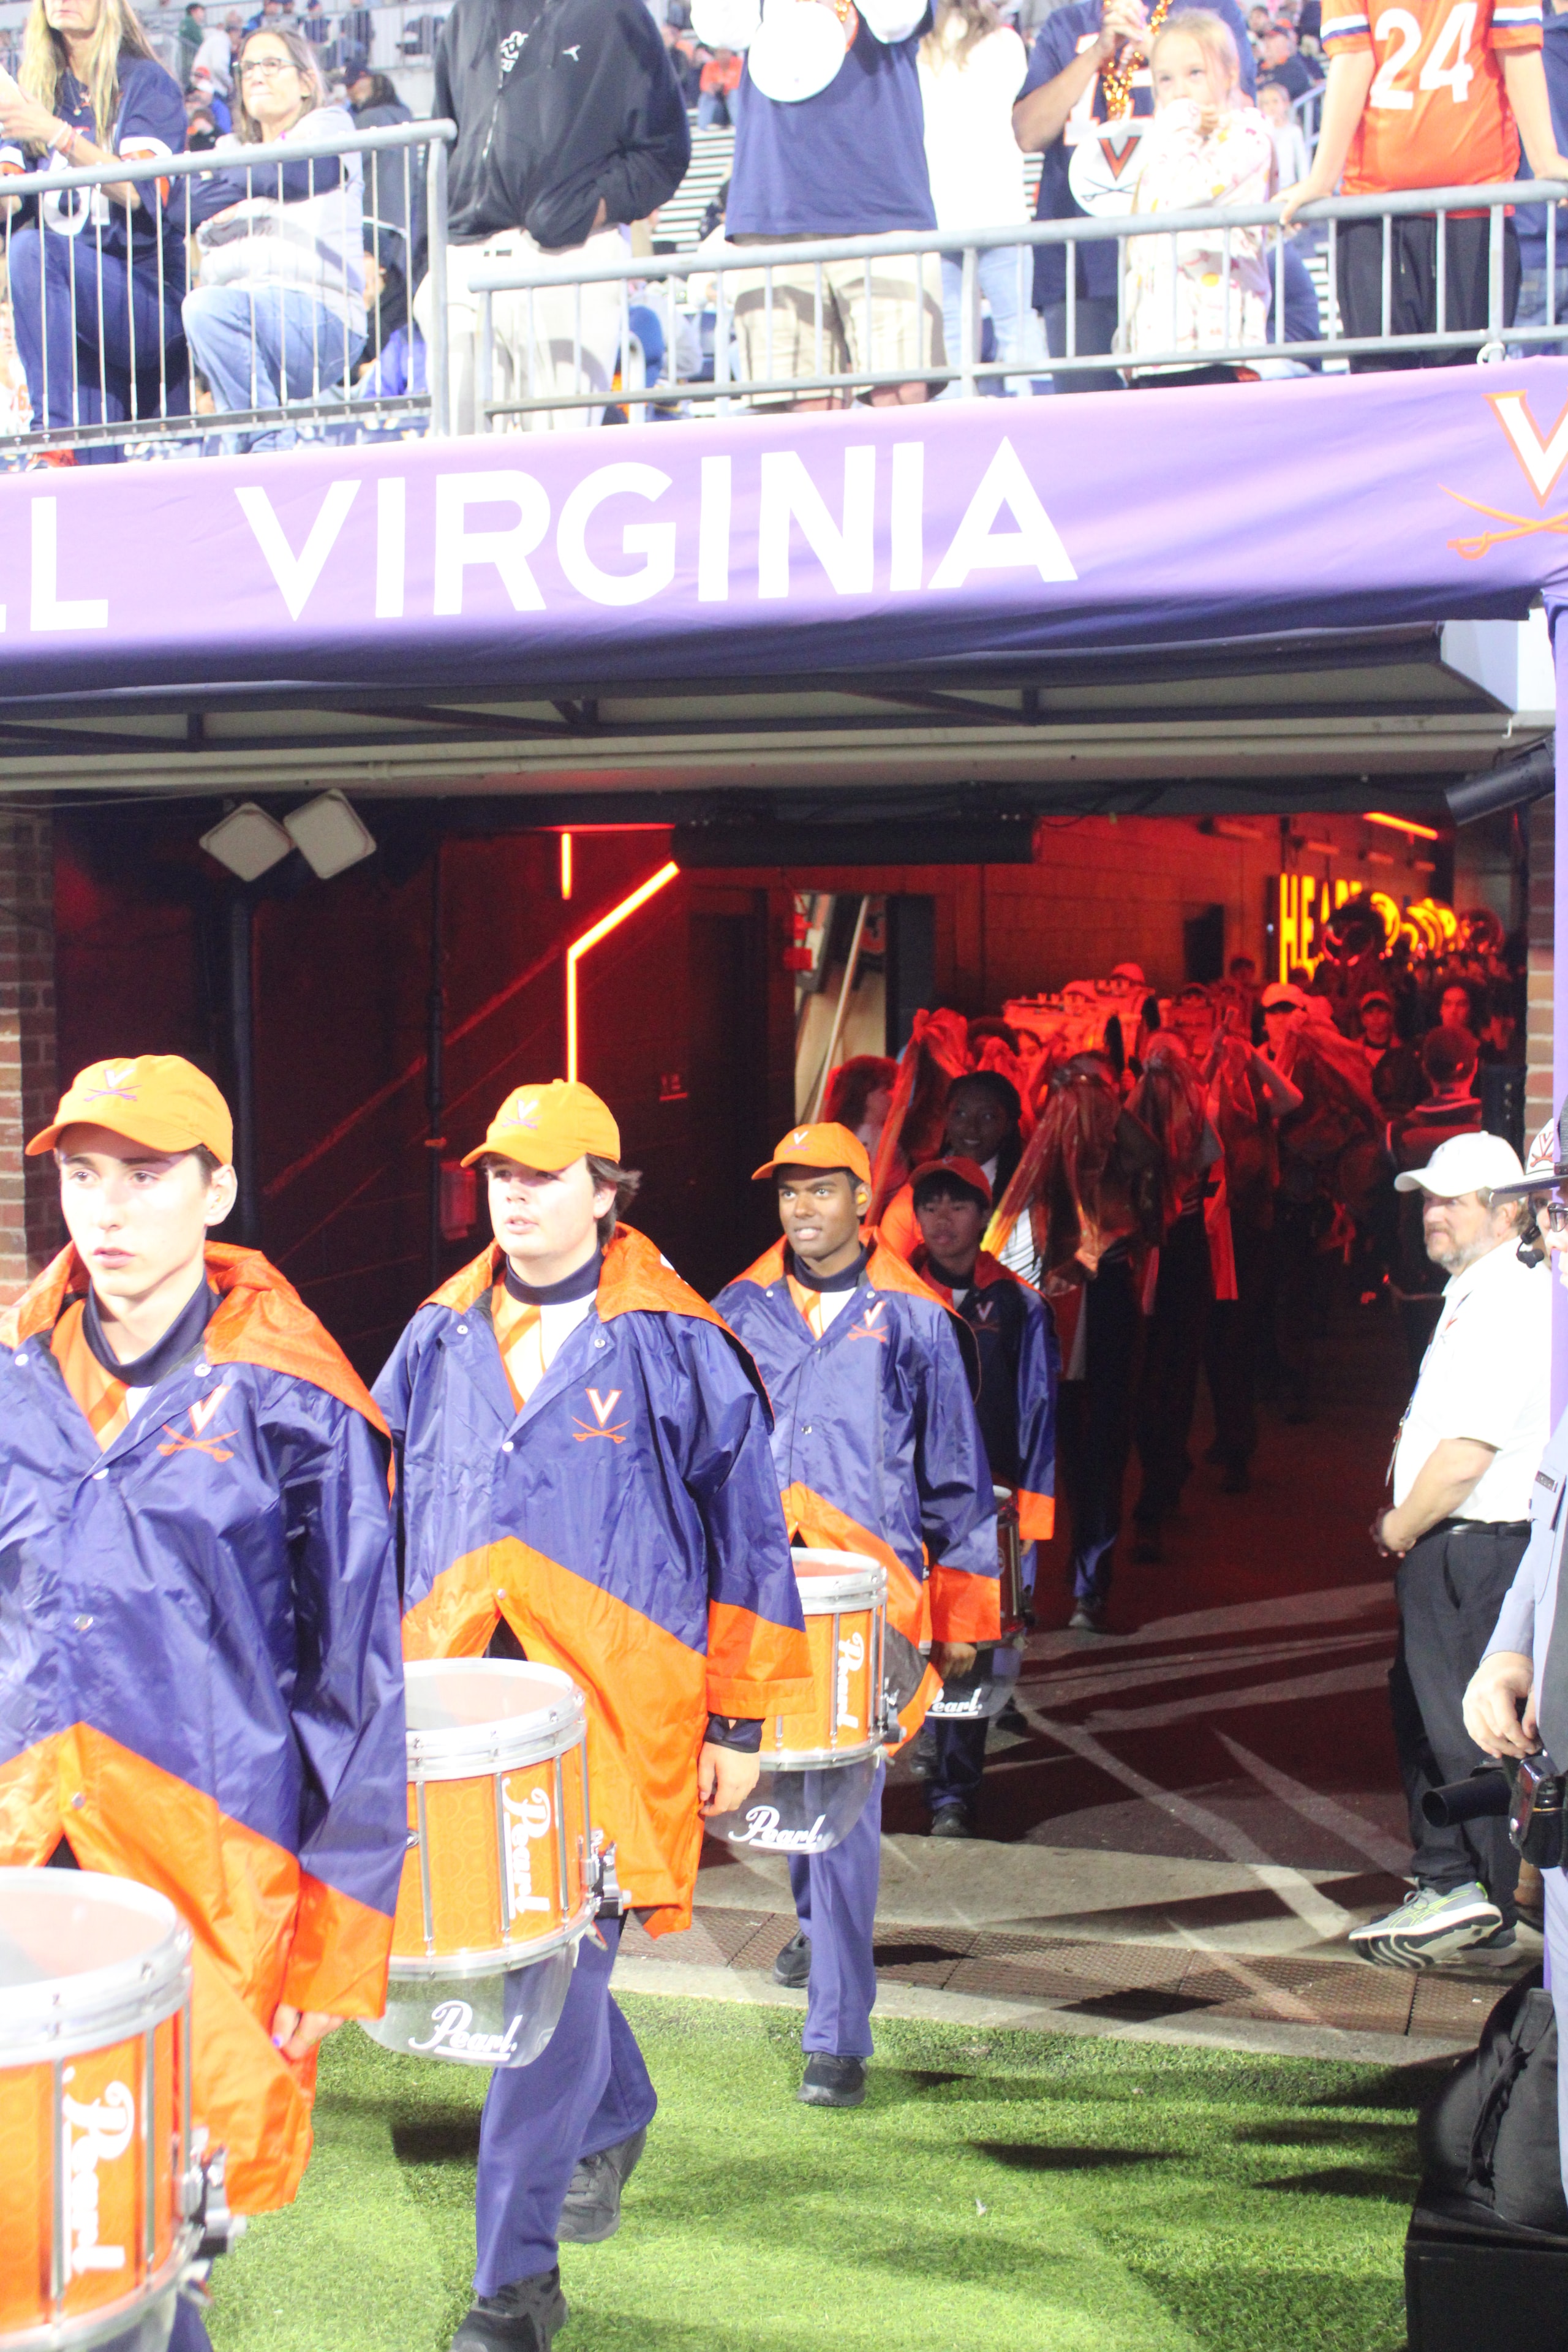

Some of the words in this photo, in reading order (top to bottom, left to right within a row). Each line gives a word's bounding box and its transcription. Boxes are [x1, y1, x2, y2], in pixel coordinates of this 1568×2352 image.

[1370, 2, 1479, 110] 24
[0, 496, 109, 632] L
[235, 435, 1077, 622] VIRGINIA
[835, 1632, 864, 1729] Pearl
[502, 1777, 551, 1916] Pearl
[728, 1804, 827, 1847] Pearl
[408, 2000, 522, 2058] Pearl
[61, 2066, 135, 2278] Pearl
